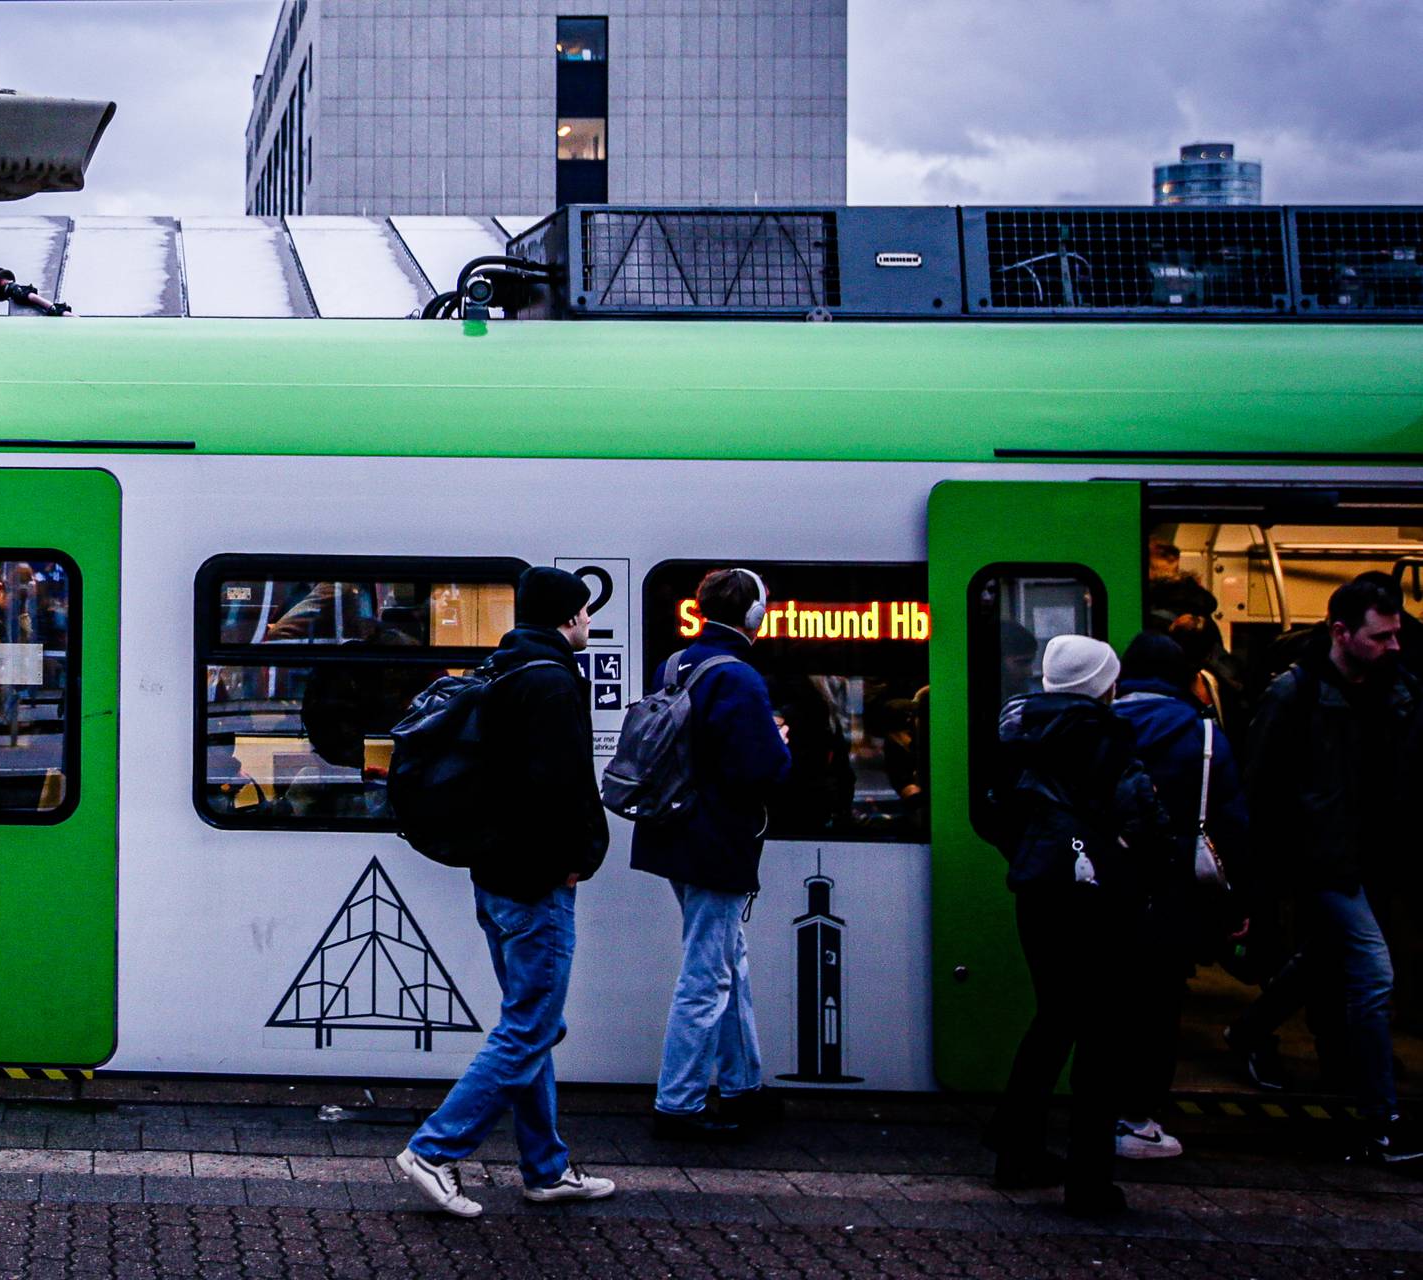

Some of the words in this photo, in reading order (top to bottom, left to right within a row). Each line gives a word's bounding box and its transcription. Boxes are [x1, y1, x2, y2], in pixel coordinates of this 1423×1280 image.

[679, 599, 702, 637] S
[757, 600, 879, 638] ortmund
[891, 601, 929, 639] Hb
